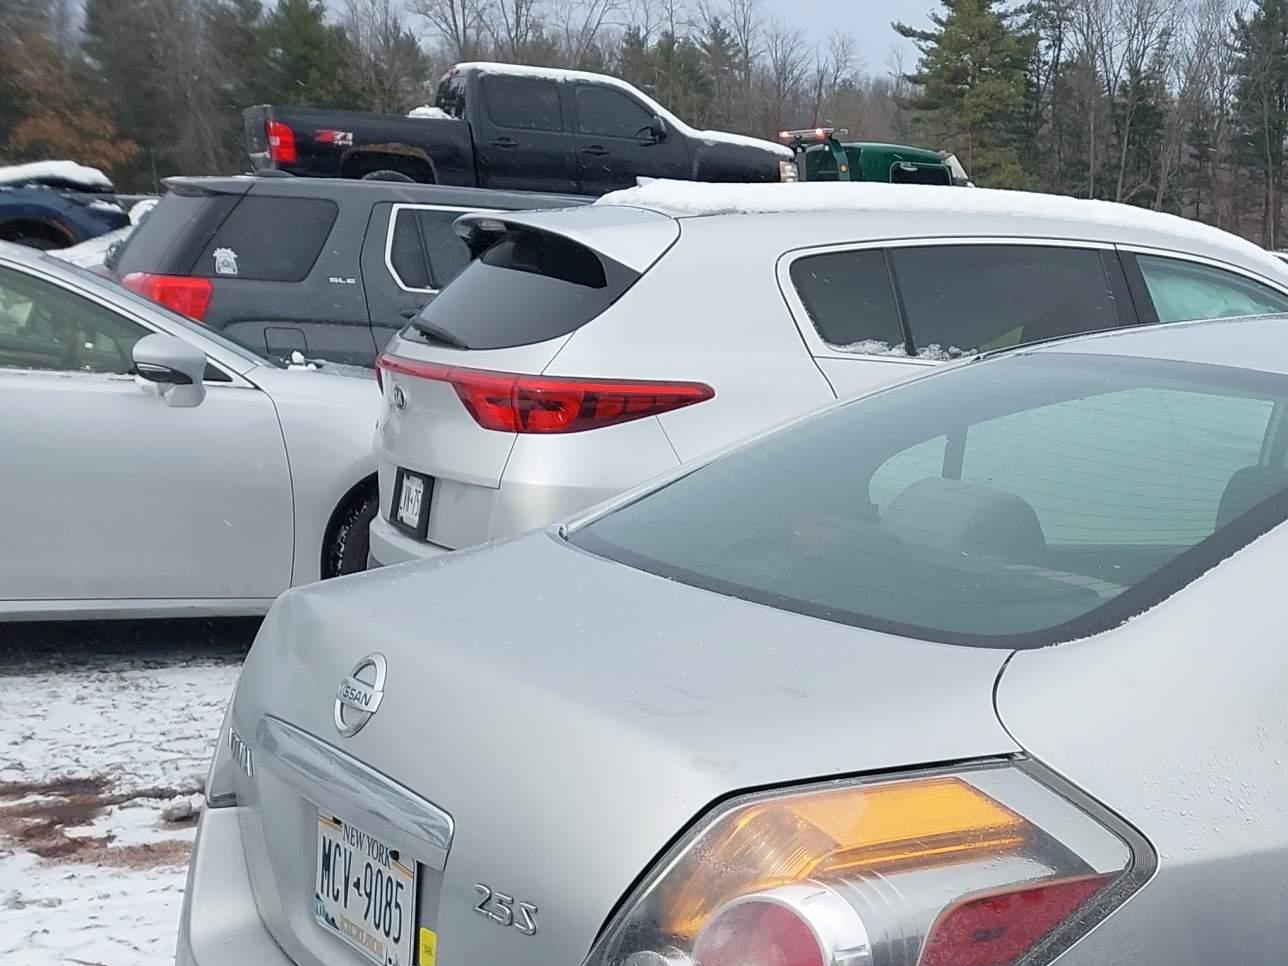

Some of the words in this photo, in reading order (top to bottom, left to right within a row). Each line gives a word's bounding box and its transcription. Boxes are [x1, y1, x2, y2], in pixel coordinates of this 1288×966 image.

[343, 824, 365, 850] NEW
[367, 836, 391, 869] YORK
[321, 836, 353, 909] MCV
[364, 862, 404, 944] 9085
